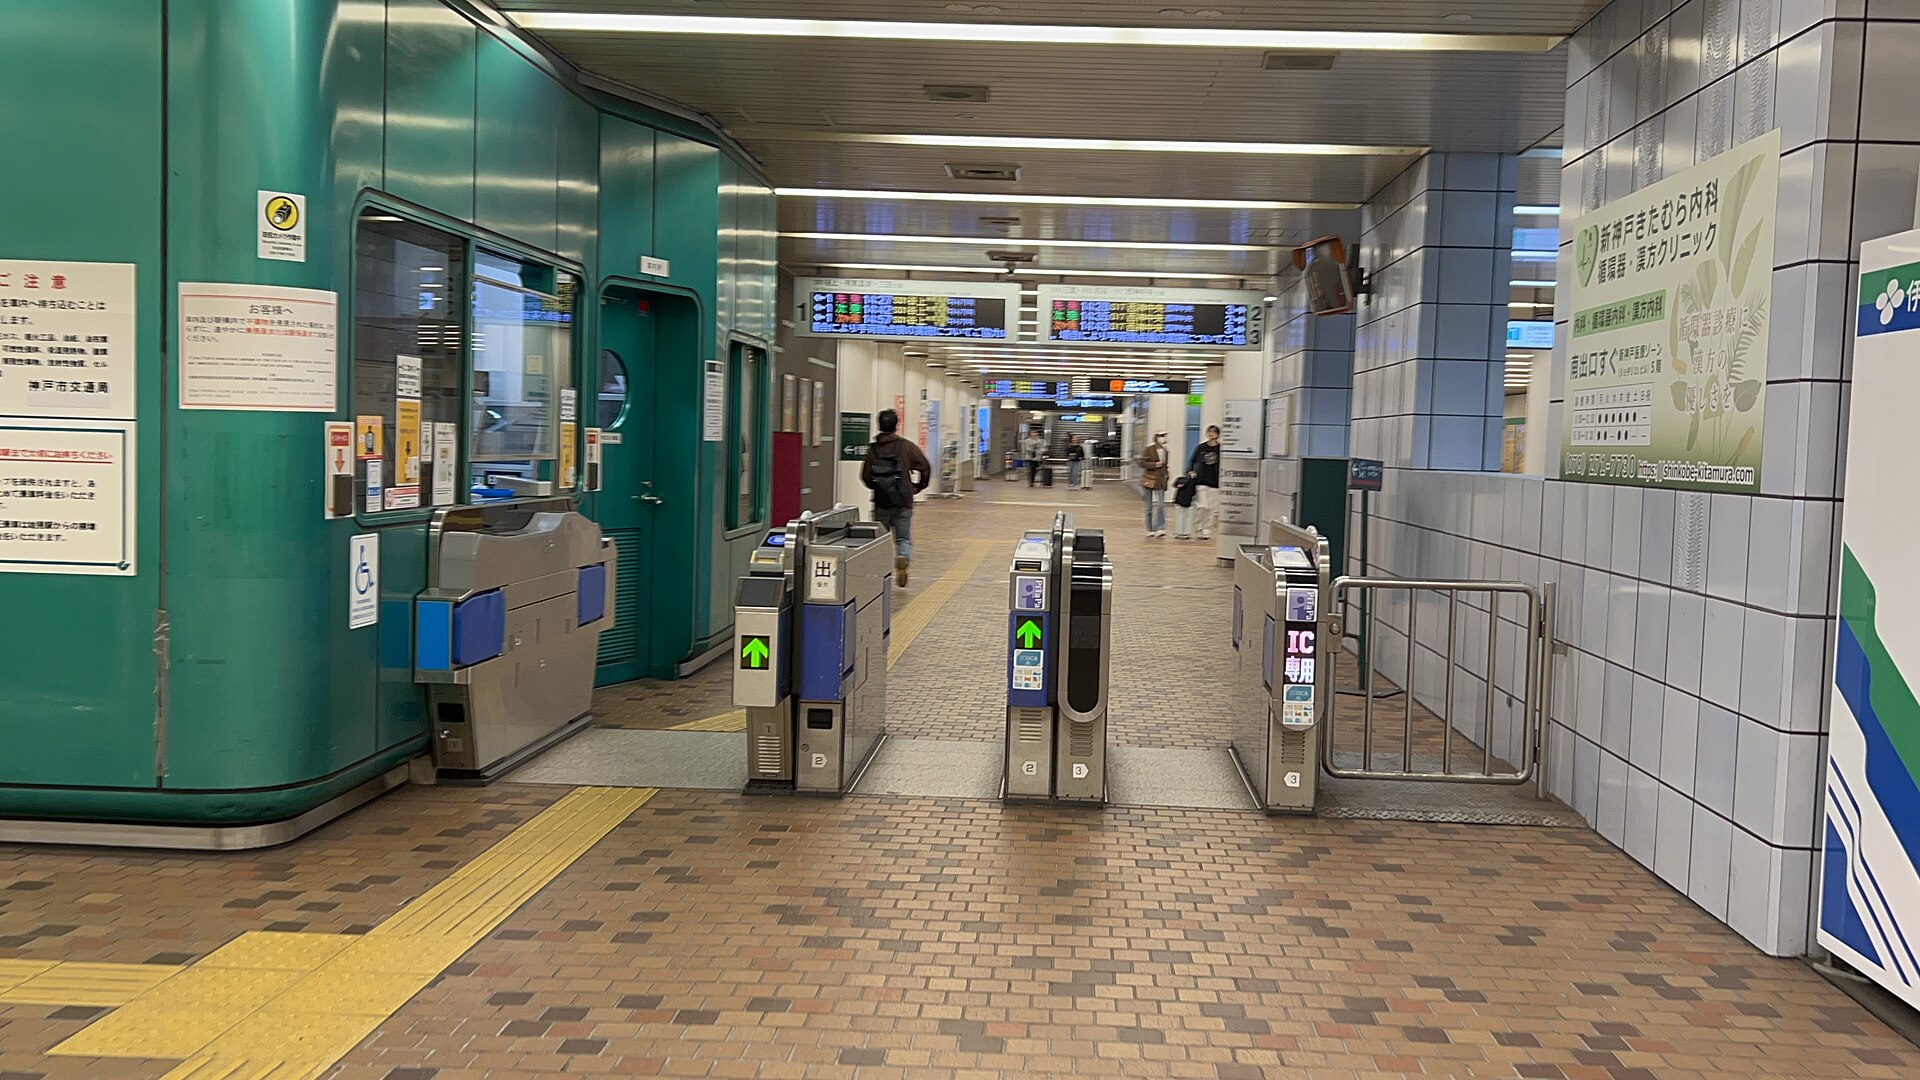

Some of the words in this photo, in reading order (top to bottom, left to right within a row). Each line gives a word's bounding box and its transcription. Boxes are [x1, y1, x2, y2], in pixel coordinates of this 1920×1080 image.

[1600, 178, 1719, 254] 新神戸きたむら内科
[1598, 222, 1717, 285] 循環器・漢方クリニック
[249, 304, 293, 316] お客様へ
[796, 303, 806, 321] 1
[1573, 294, 1663, 334] 内科・循環器内科・漢方内科
[1679, 306, 1748, 342] 循環器診療に
[1570, 348, 1618, 379] 南出口すぐ
[1693, 348, 1727, 375] 漢方の
[28, 380, 109, 394] 神戸市交通局
[1685, 384, 1732, 412] 優しさを
[1588, 453, 1636, 478] 271-7730
[815, 560, 831, 578] 出
[1034, 579, 1043, 608] PiTaPa
[1306, 591, 1315, 620] PiTaPa
[1287, 630, 1315, 654] IC
[1284, 656, 1315, 683] 専用
[815, 756, 823, 765] 2
[1025, 764, 1034, 773] 2
[1075, 767, 1082, 776] 3
[1290, 775, 1297, 784] 3
